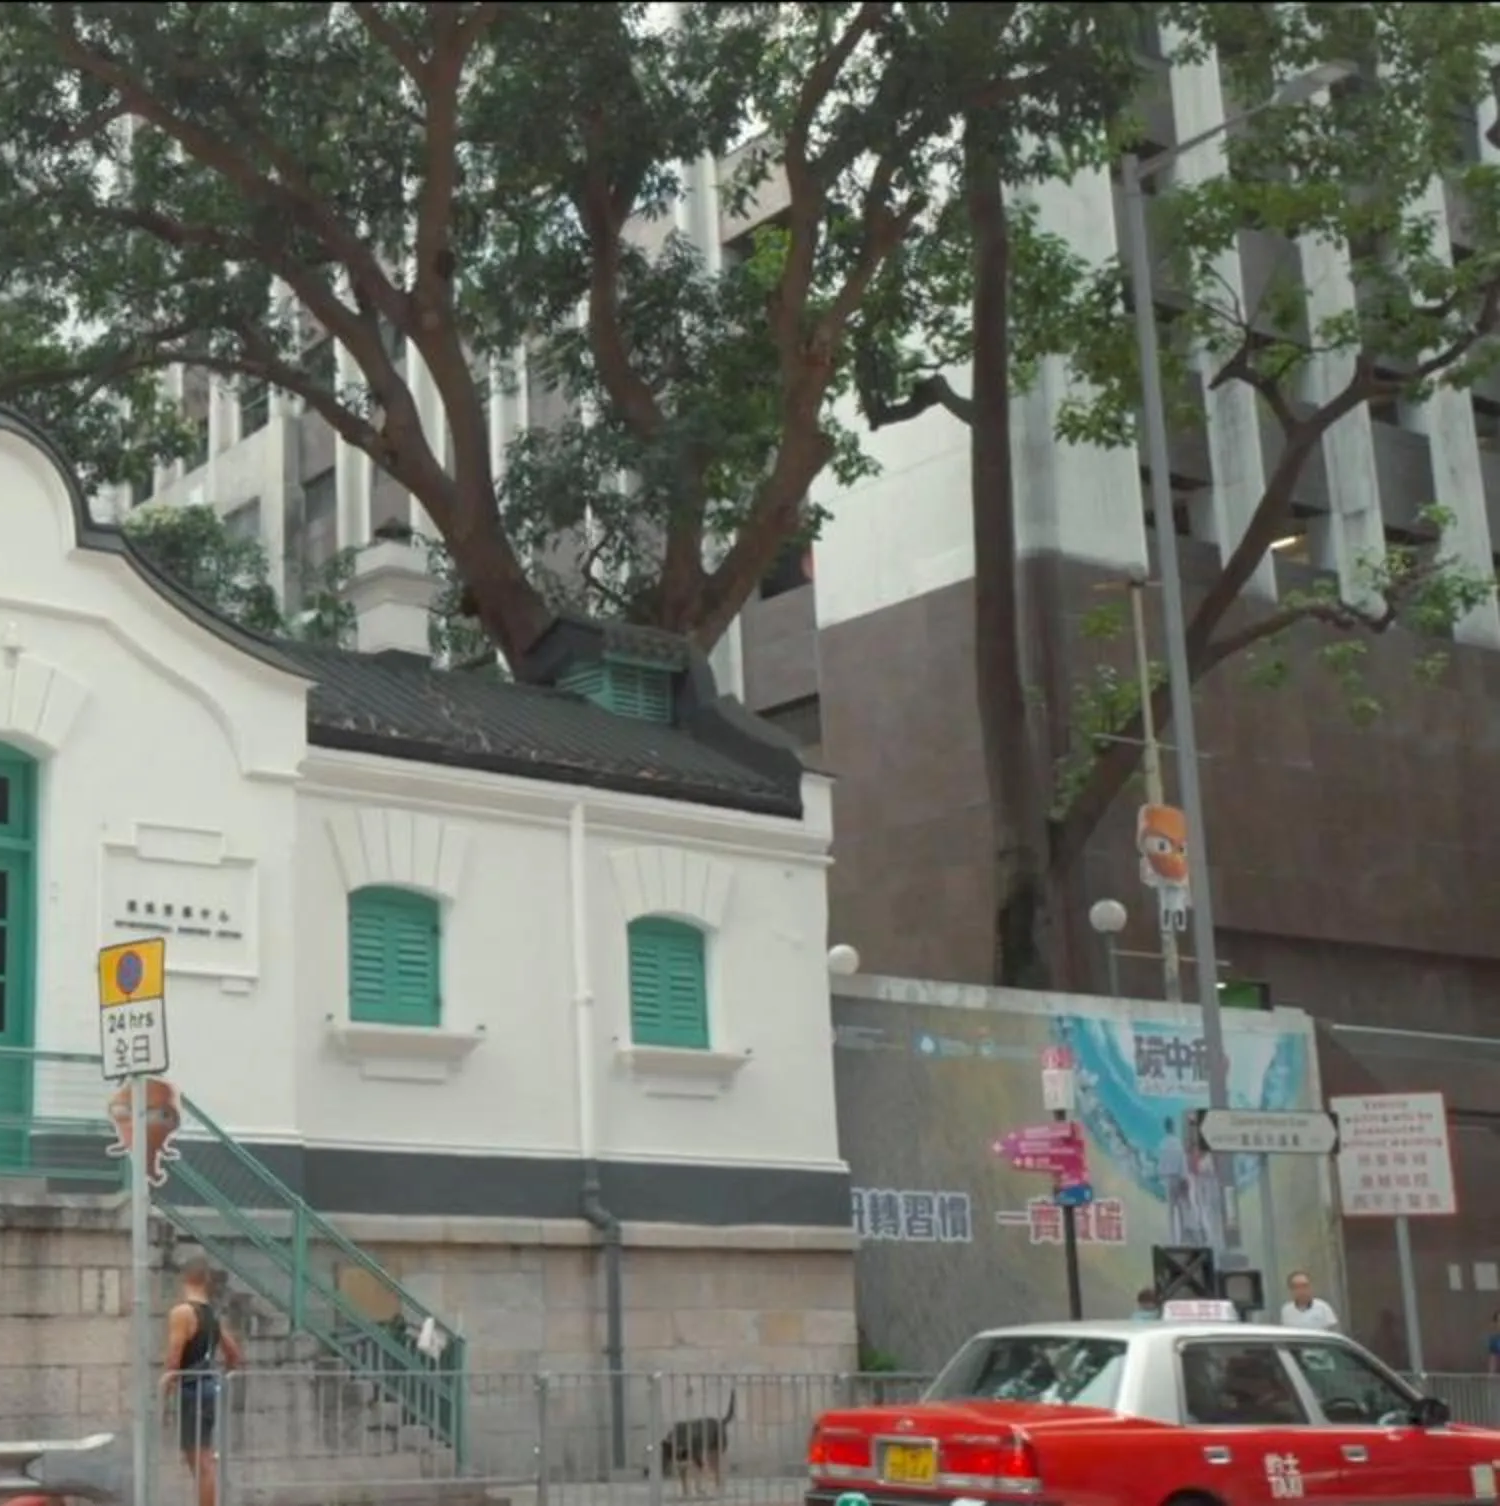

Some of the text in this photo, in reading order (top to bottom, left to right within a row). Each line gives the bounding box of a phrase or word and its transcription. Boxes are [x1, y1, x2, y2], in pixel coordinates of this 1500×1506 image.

[107, 1010, 155, 1034] 24 hrs
[115, 1034, 151, 1069] 全日
[1264, 1452, 1300, 1477] 的士
